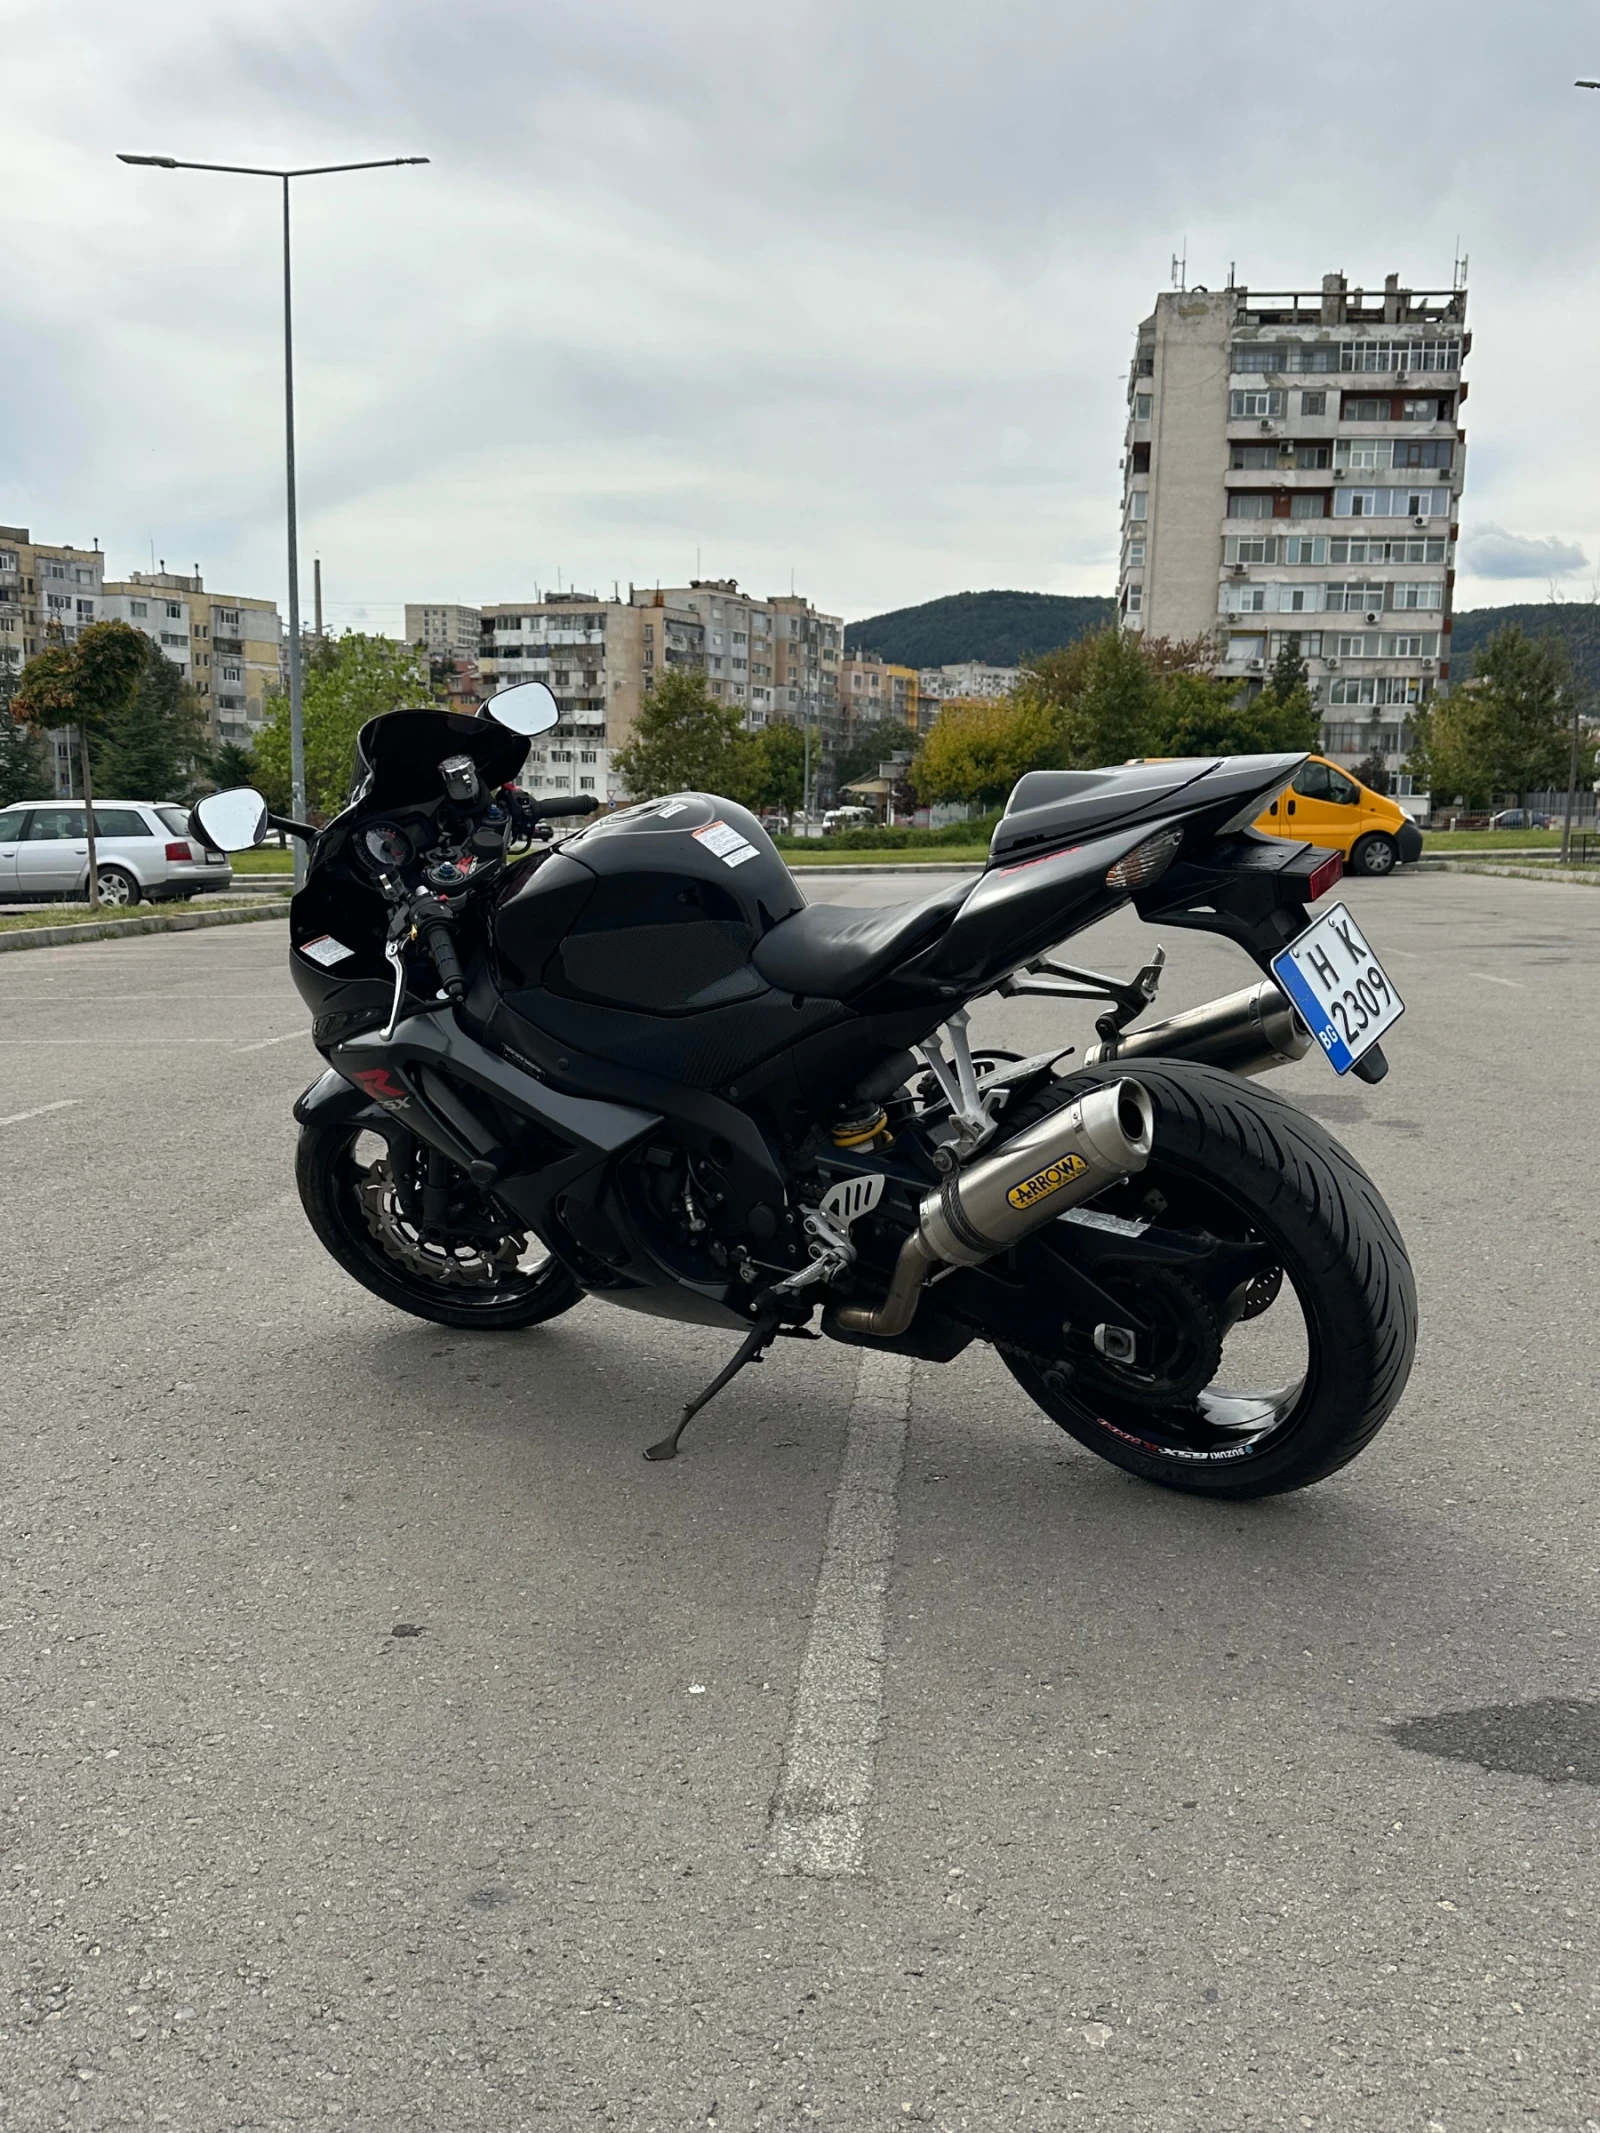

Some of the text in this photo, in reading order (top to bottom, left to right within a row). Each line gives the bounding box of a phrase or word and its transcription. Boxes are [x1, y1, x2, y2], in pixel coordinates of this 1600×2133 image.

[1306, 919, 1367, 991] H K
[1331, 966, 1391, 1044] 2309
[1318, 1024, 1339, 1050] BG
[1016, 1156, 1076, 1204] ARROW
[1210, 1447, 1245, 1460] SUZUKI
